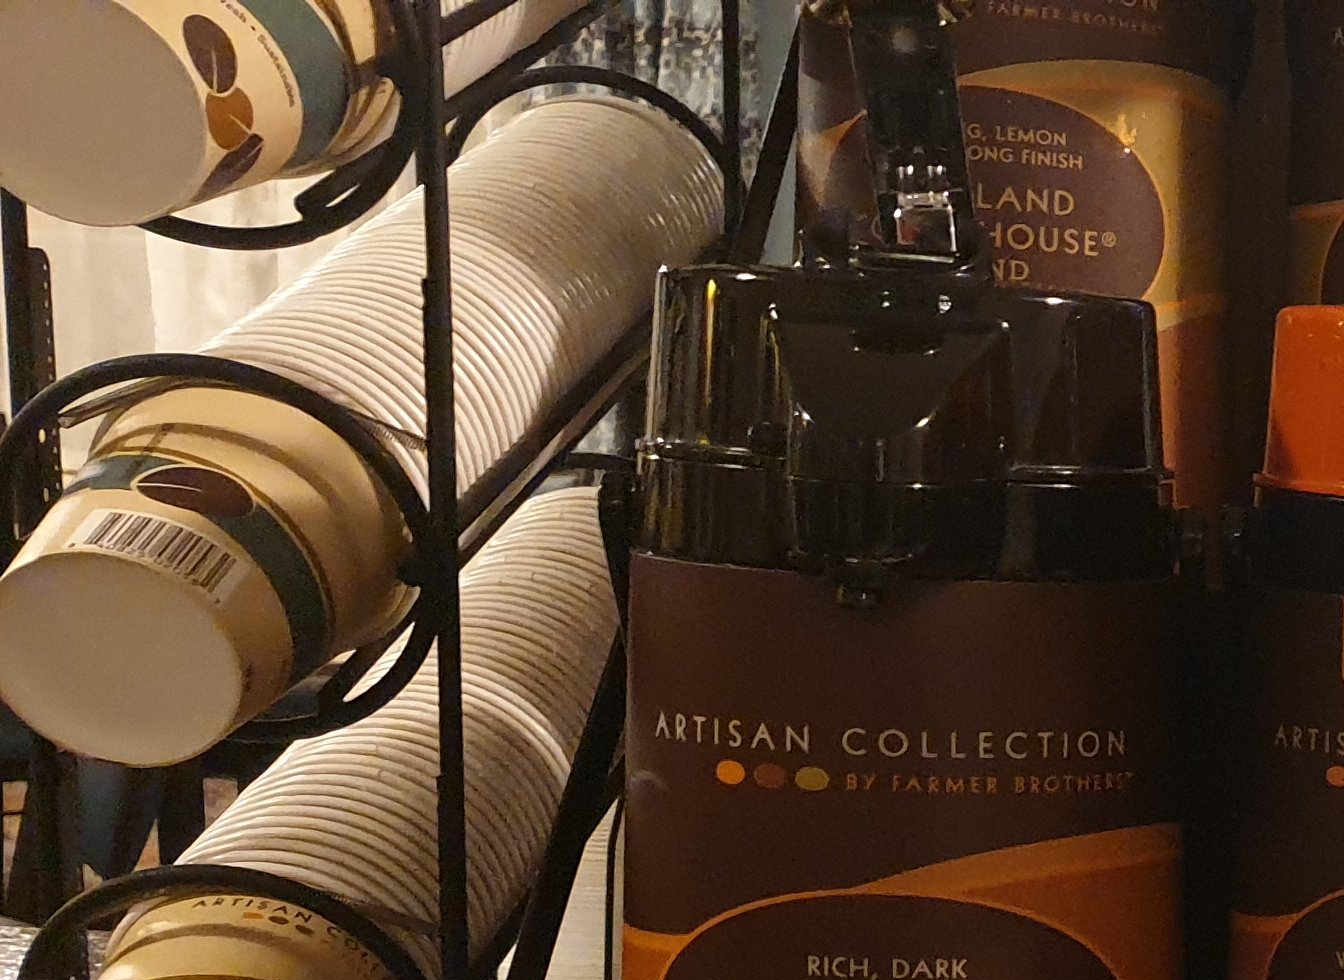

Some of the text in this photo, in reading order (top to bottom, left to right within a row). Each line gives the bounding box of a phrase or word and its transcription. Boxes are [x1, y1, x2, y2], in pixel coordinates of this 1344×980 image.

[996, 126, 1068, 147] LEMON
[1021, 150, 1084, 170] FINISH
[655, 709, 1126, 761] ARTISAN COLLECTION
[846, 772, 876, 791] BY
[891, 774, 999, 795] FARMER
[192, 897, 313, 924] ARTISAN
[807, 955, 968, 980] RICH, DARK
